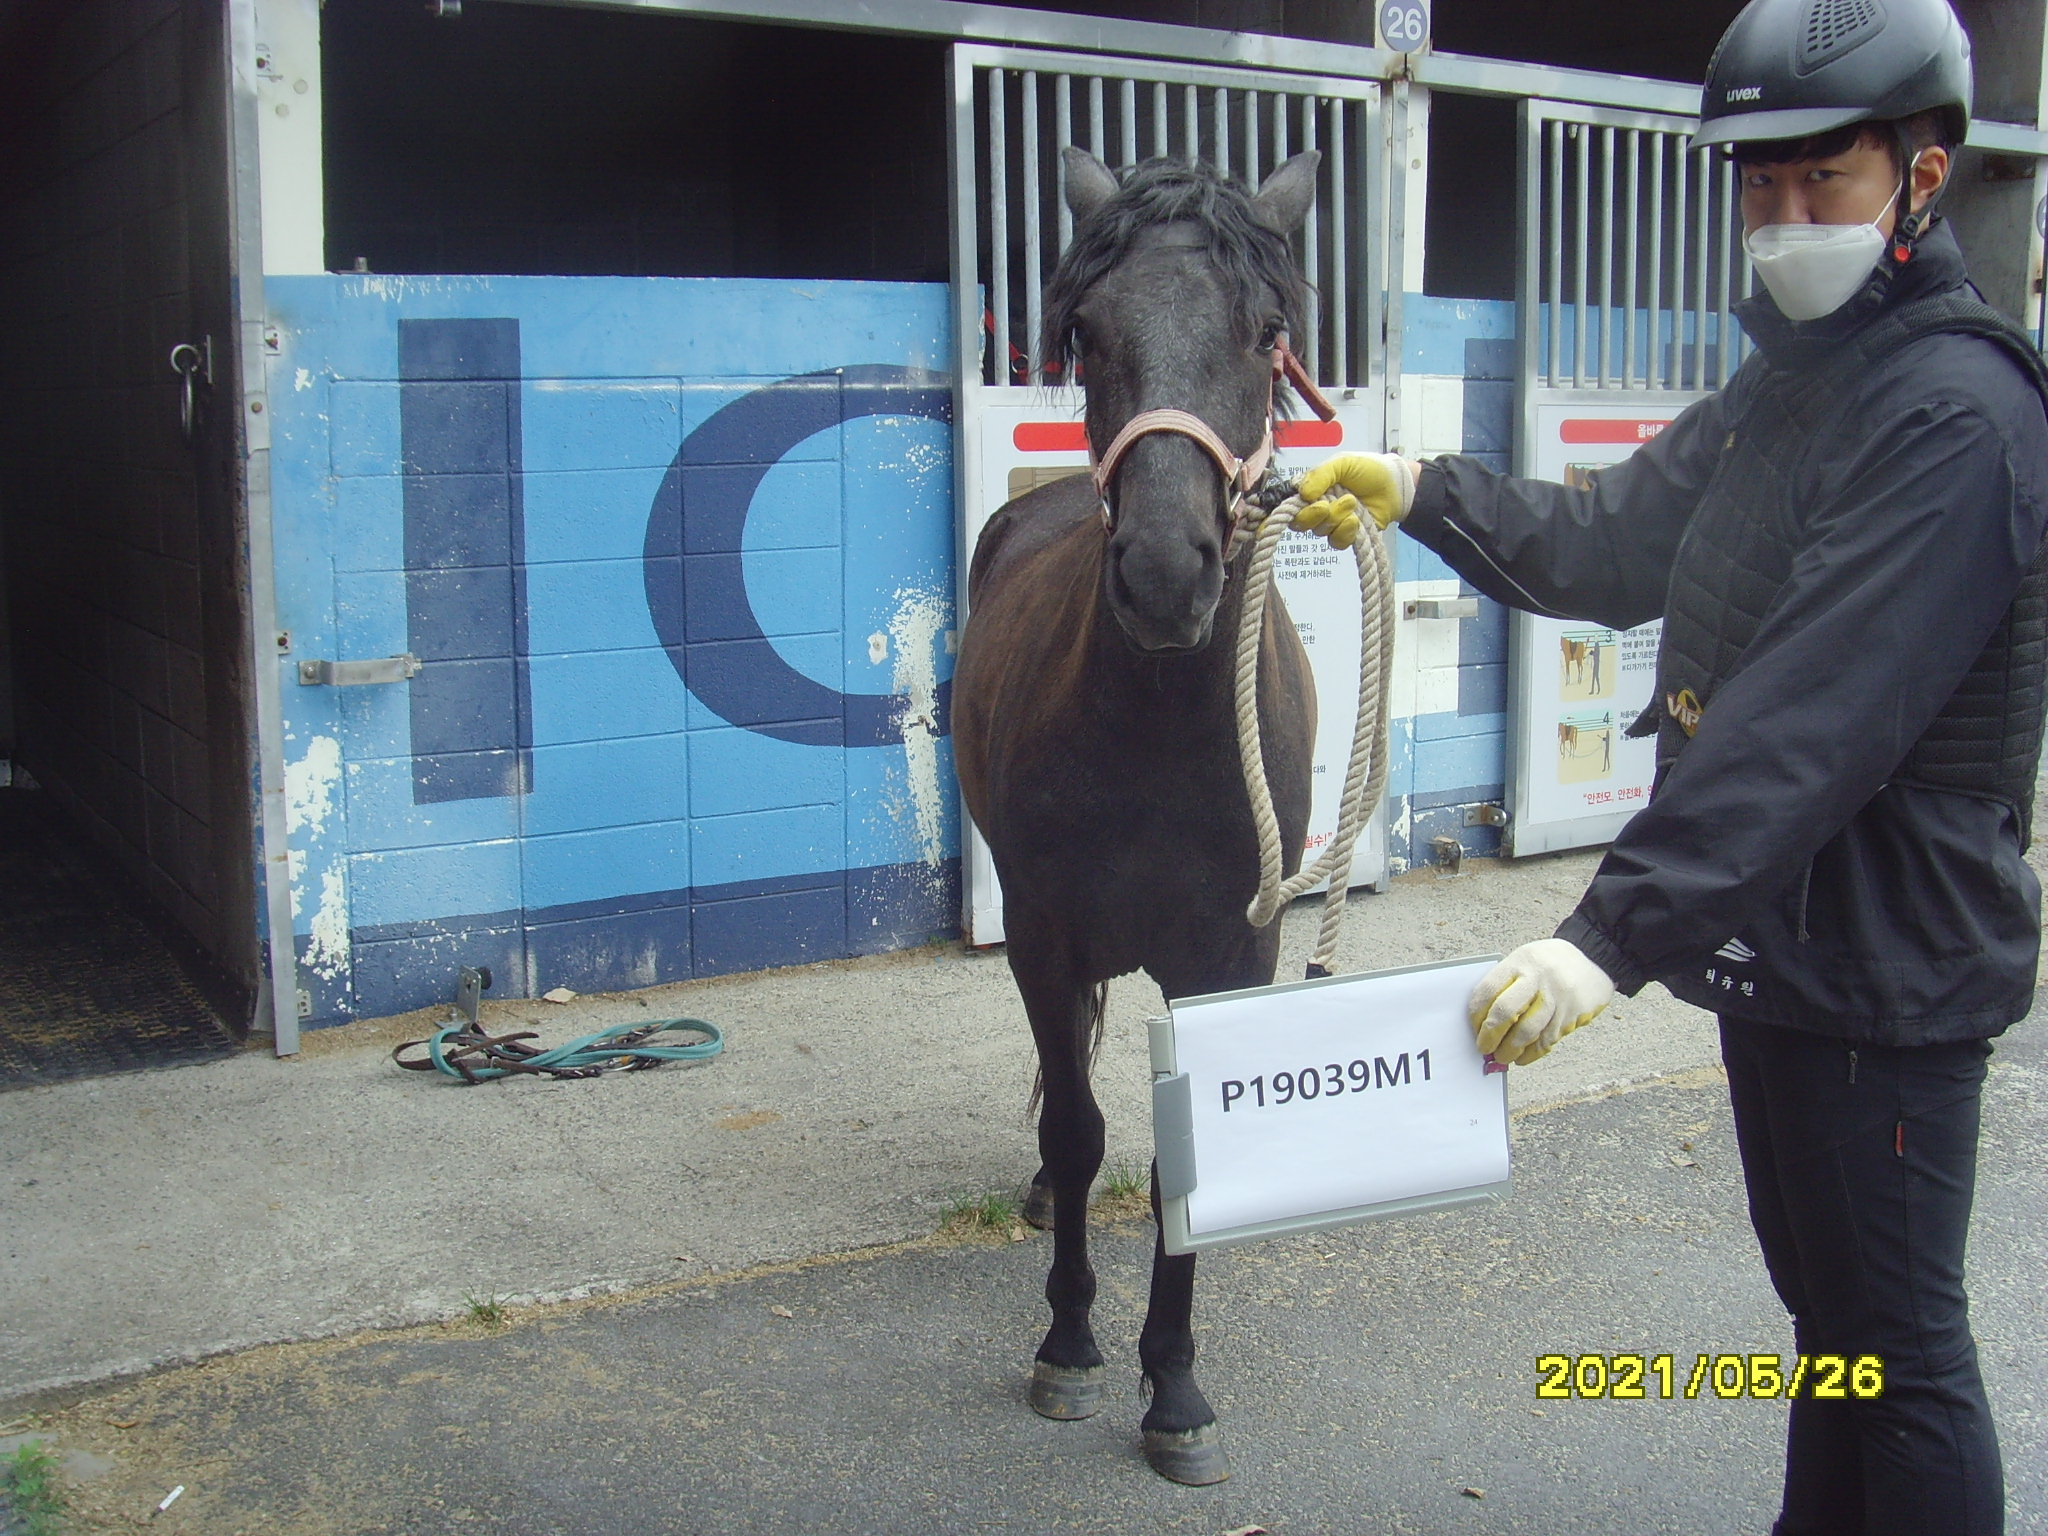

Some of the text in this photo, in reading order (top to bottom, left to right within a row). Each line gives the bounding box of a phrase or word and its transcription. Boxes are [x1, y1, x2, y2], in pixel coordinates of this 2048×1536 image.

[1387, 6, 1422, 41] 26
[1726, 86, 1761, 103] uvex
[1606, 630, 1612, 643] 3
[1603, 711, 1609, 725] 4
[1221, 1048, 1432, 1113] P19039M1
